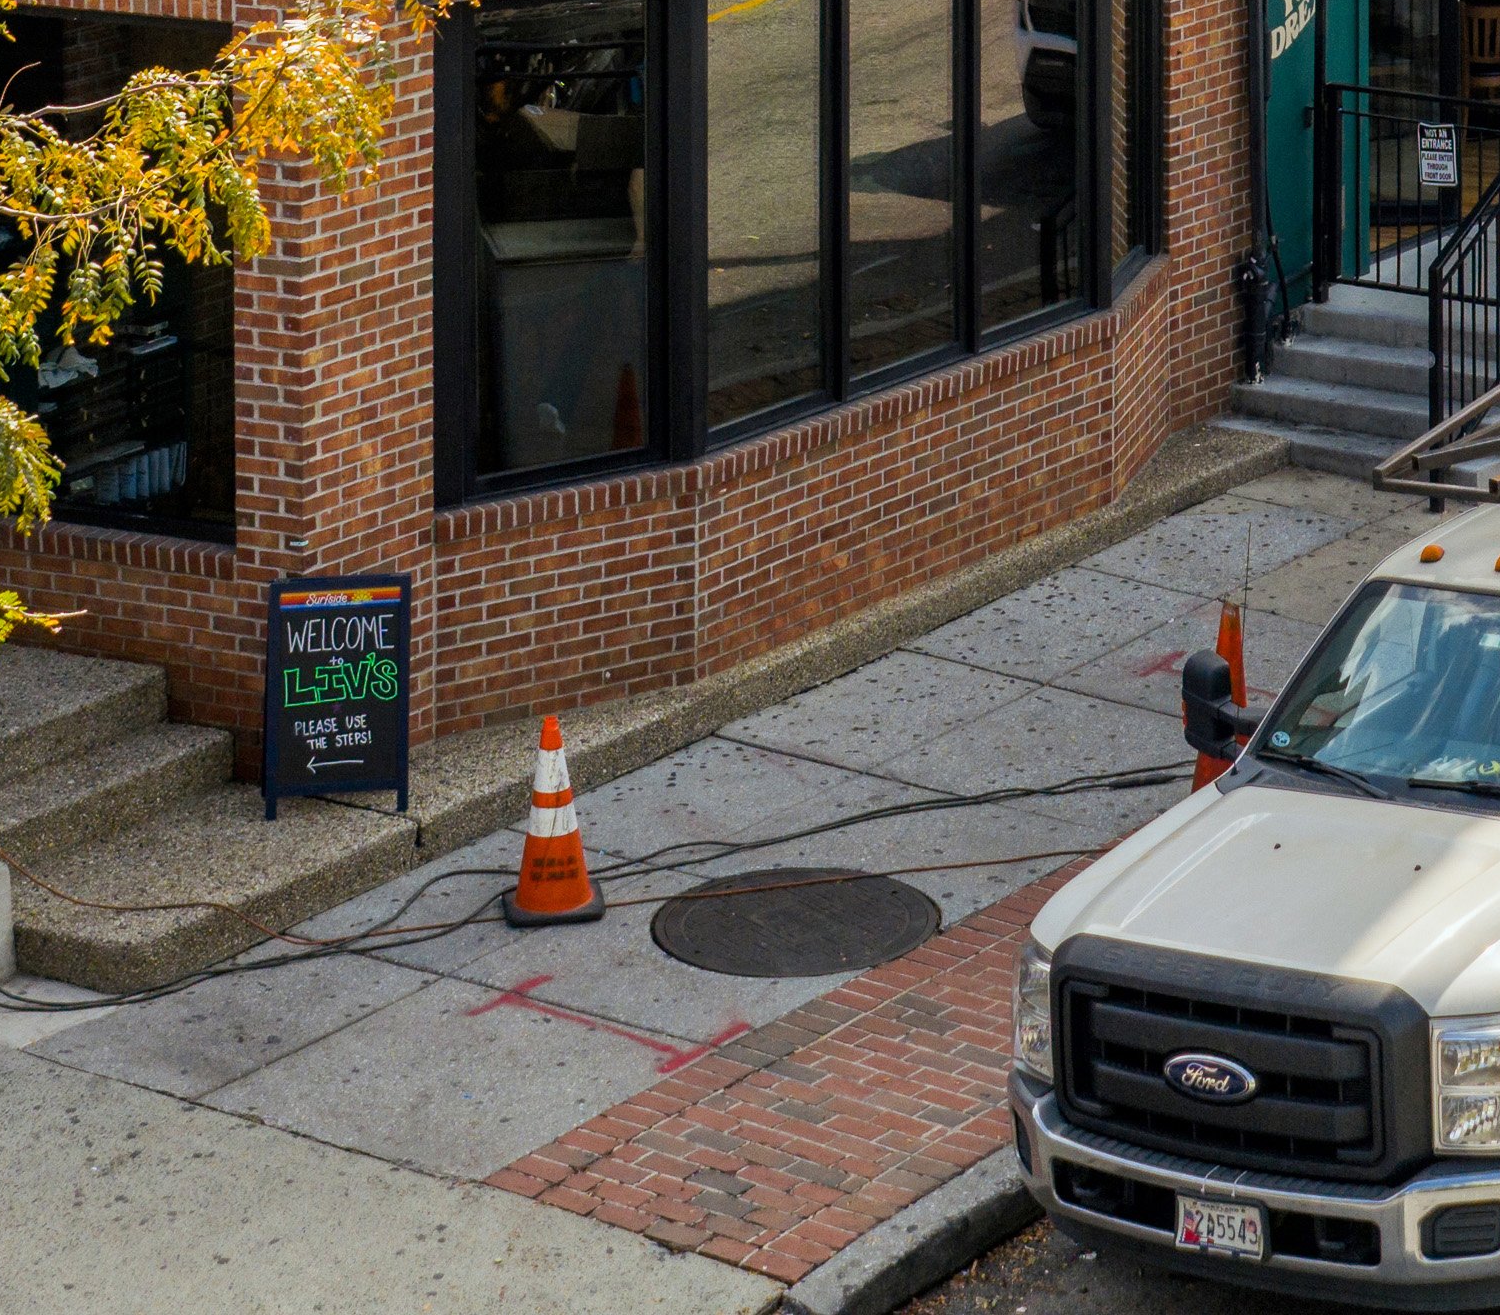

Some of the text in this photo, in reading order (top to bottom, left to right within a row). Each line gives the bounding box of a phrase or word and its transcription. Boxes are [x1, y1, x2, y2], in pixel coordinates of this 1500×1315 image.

[1424, 128, 1448, 139] NOT AN
[1421, 138, 1453, 150] ENTRANCE
[305, 592, 348, 607] Surfside
[286, 613, 395, 654] WELCOME
[328, 655, 345, 667] to
[283, 652, 398, 707] LIV'S
[294, 713, 368, 737] PLEASE USE
[306, 730, 373, 750] THE STEPS!
[1181, 1062, 1231, 1093] Ford
